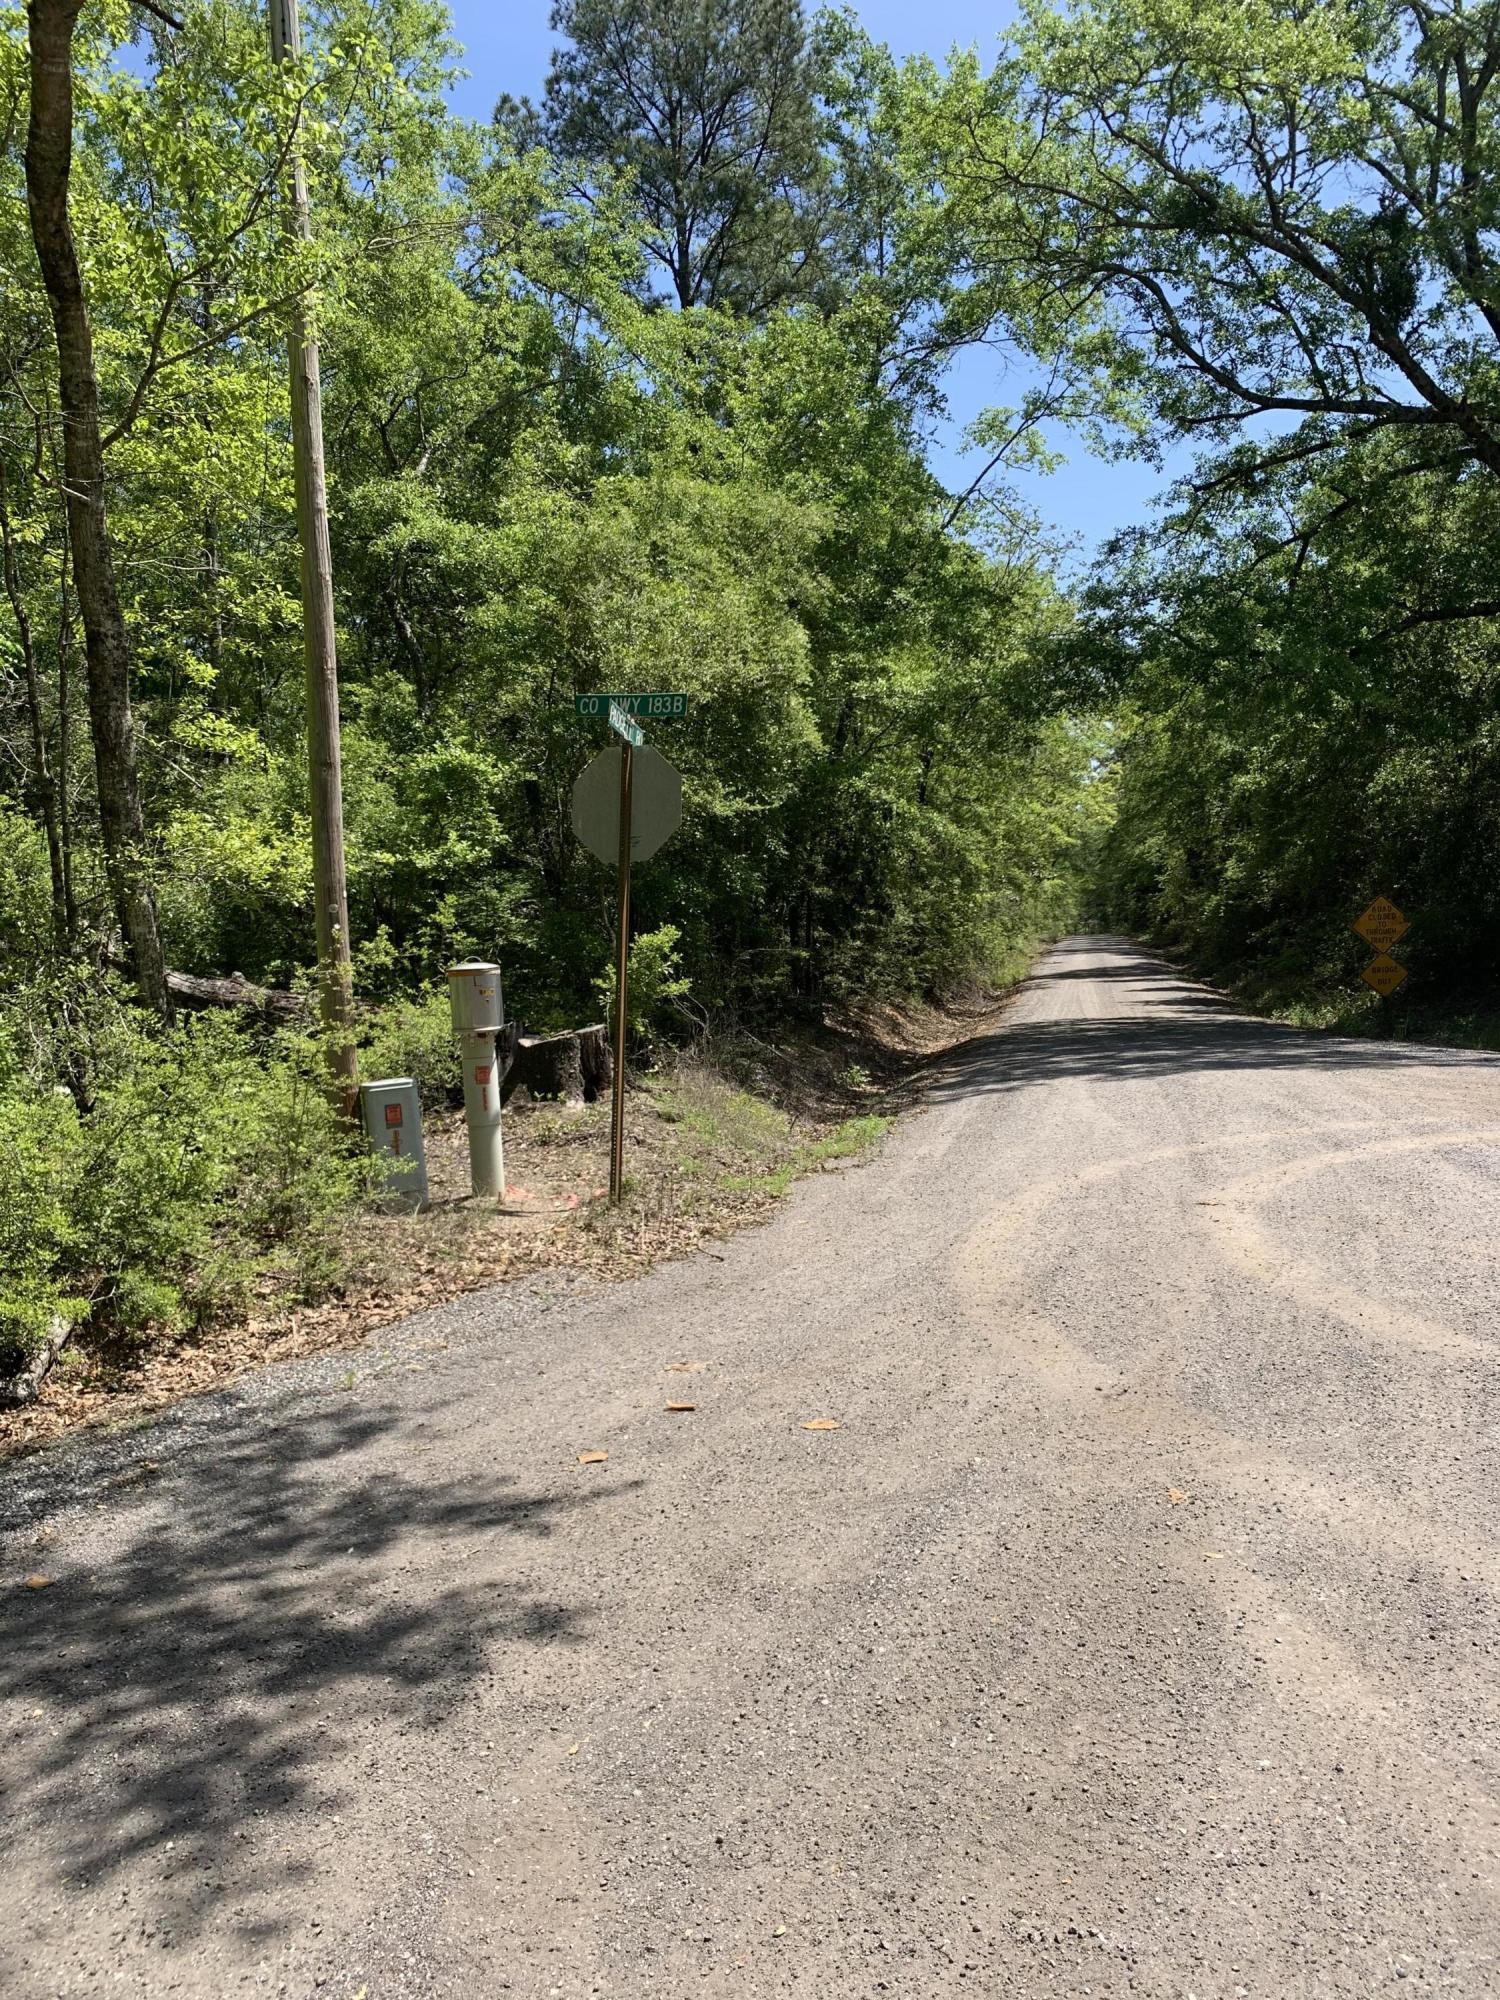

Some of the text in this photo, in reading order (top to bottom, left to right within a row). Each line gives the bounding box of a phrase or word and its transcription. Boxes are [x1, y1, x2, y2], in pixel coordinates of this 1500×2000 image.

[580, 698, 599, 714] CO
[648, 696, 683, 714] 183B
[1372, 904, 1392, 912] ROAD
[1368, 912, 1396, 920] CLOSED
